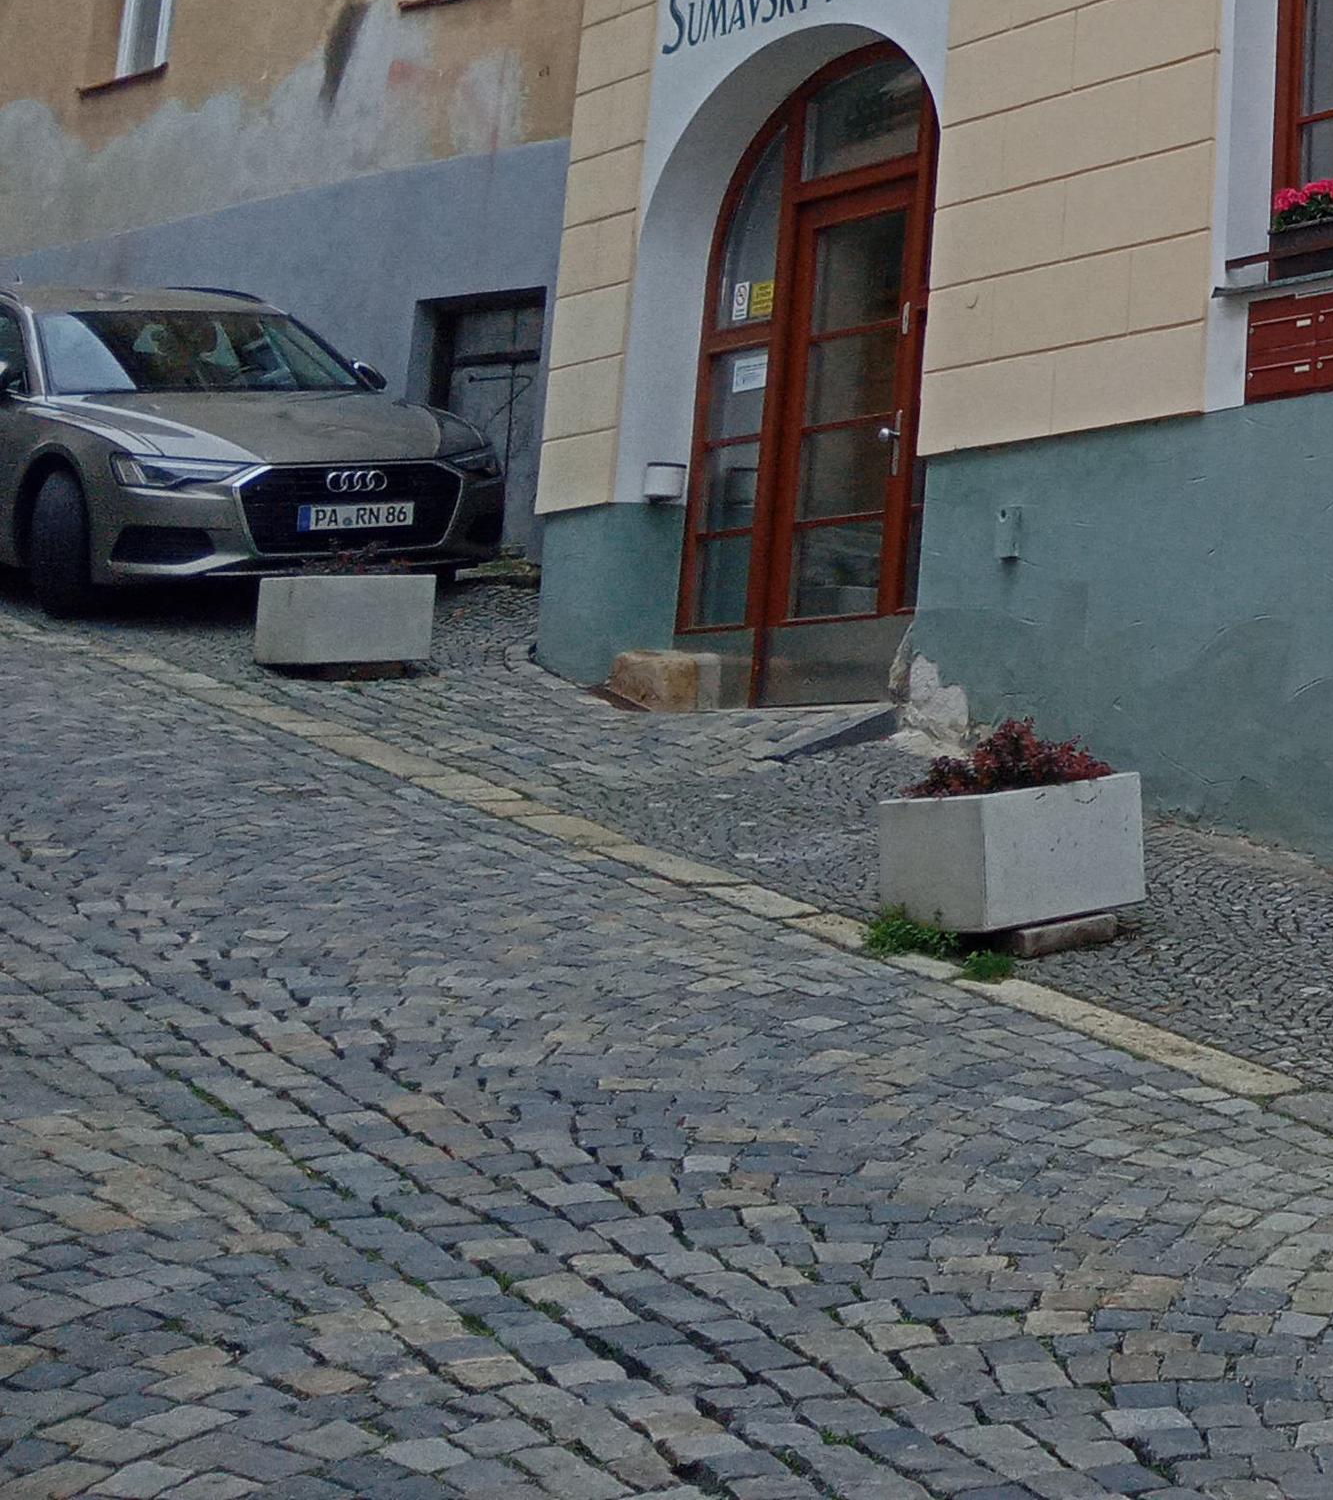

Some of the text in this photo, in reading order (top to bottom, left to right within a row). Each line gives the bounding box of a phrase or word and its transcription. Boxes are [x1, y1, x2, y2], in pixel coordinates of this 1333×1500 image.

[314, 504, 408, 527] PA RN 86
